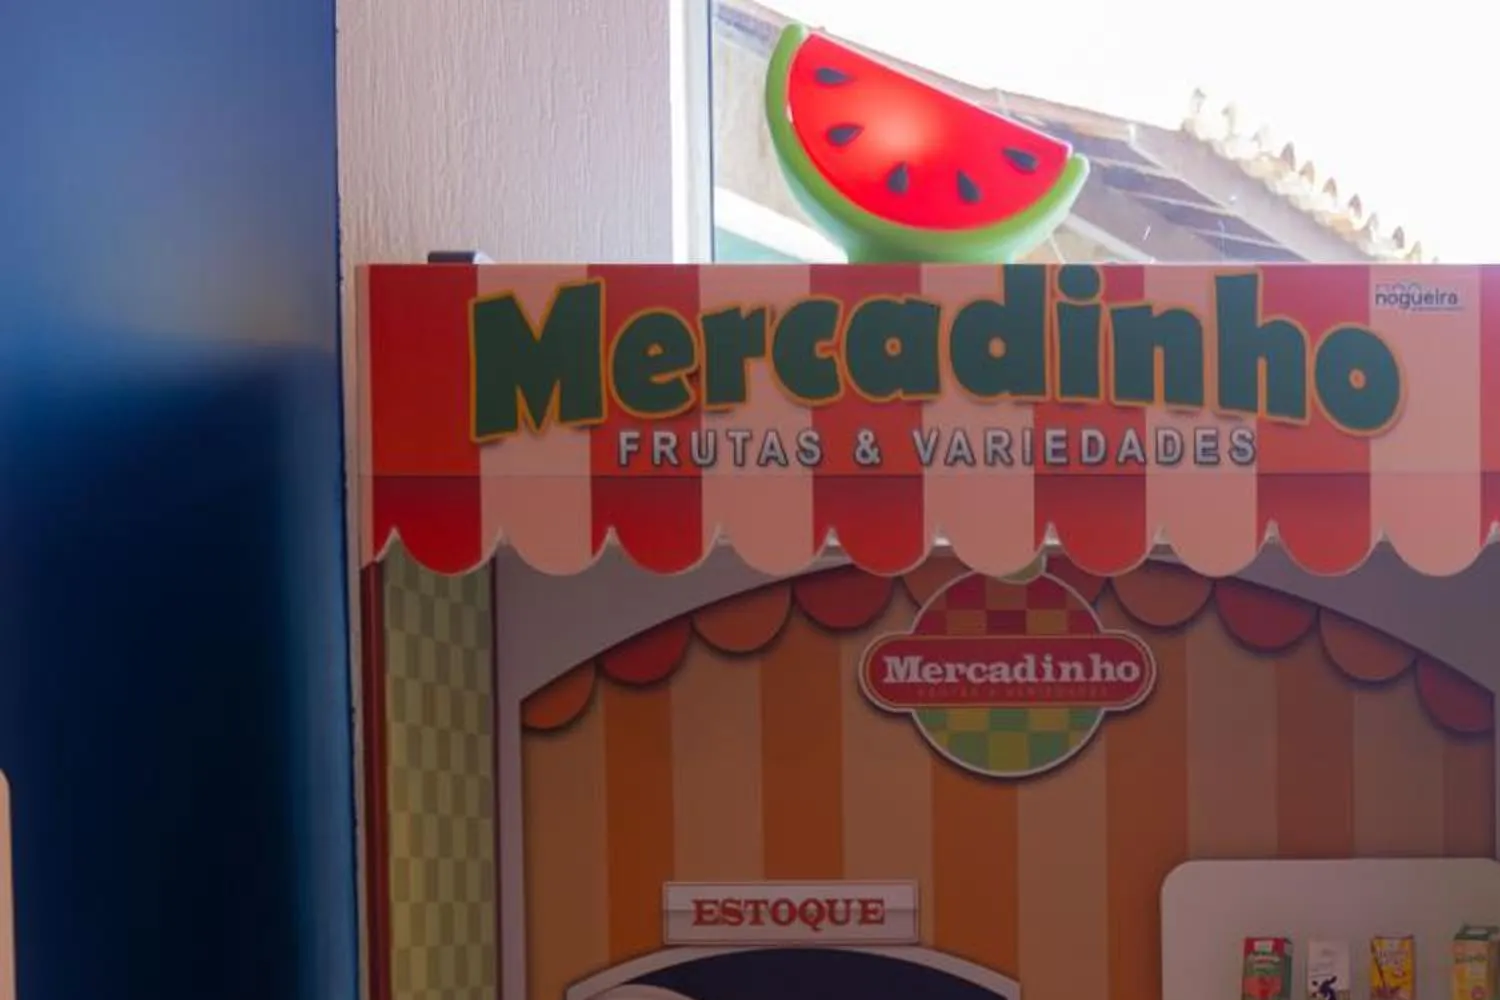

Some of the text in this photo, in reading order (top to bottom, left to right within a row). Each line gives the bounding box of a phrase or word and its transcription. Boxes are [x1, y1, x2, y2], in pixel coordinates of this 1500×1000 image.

[1375, 287, 1458, 309] nogueira
[470, 262, 1407, 446] Mercadinho
[617, 427, 1258, 468] FRUTAS & VARIEDADES
[882, 653, 1141, 685] Mercadinho
[692, 898, 886, 931] ESTOQUE
